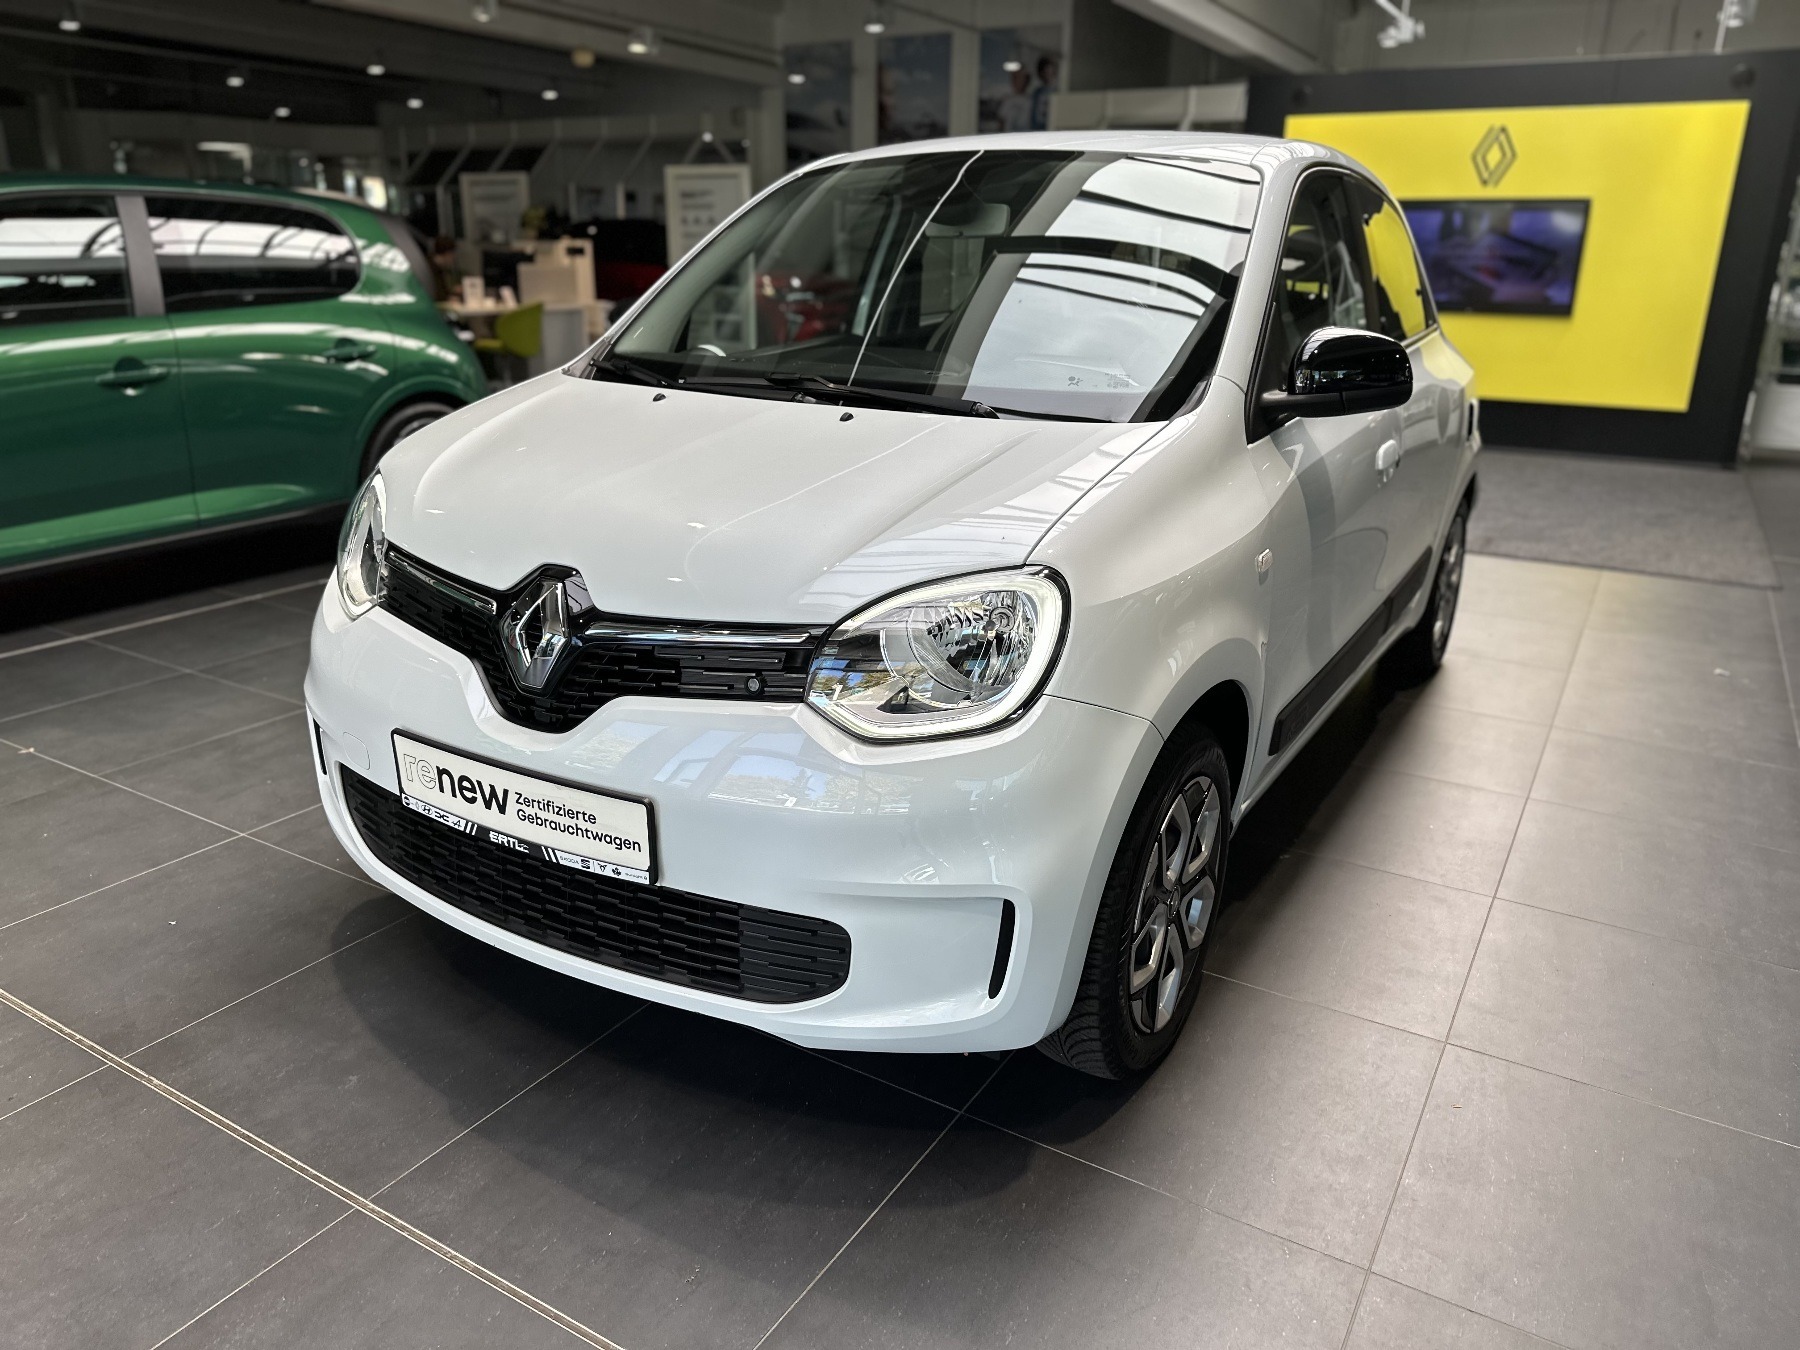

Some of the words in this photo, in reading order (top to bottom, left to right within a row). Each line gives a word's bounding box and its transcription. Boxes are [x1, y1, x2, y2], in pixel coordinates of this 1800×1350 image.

[403, 753, 509, 815] renew
[514, 791, 597, 825] Zertifizierte
[516, 808, 642, 853] Gebrauchtwagen
